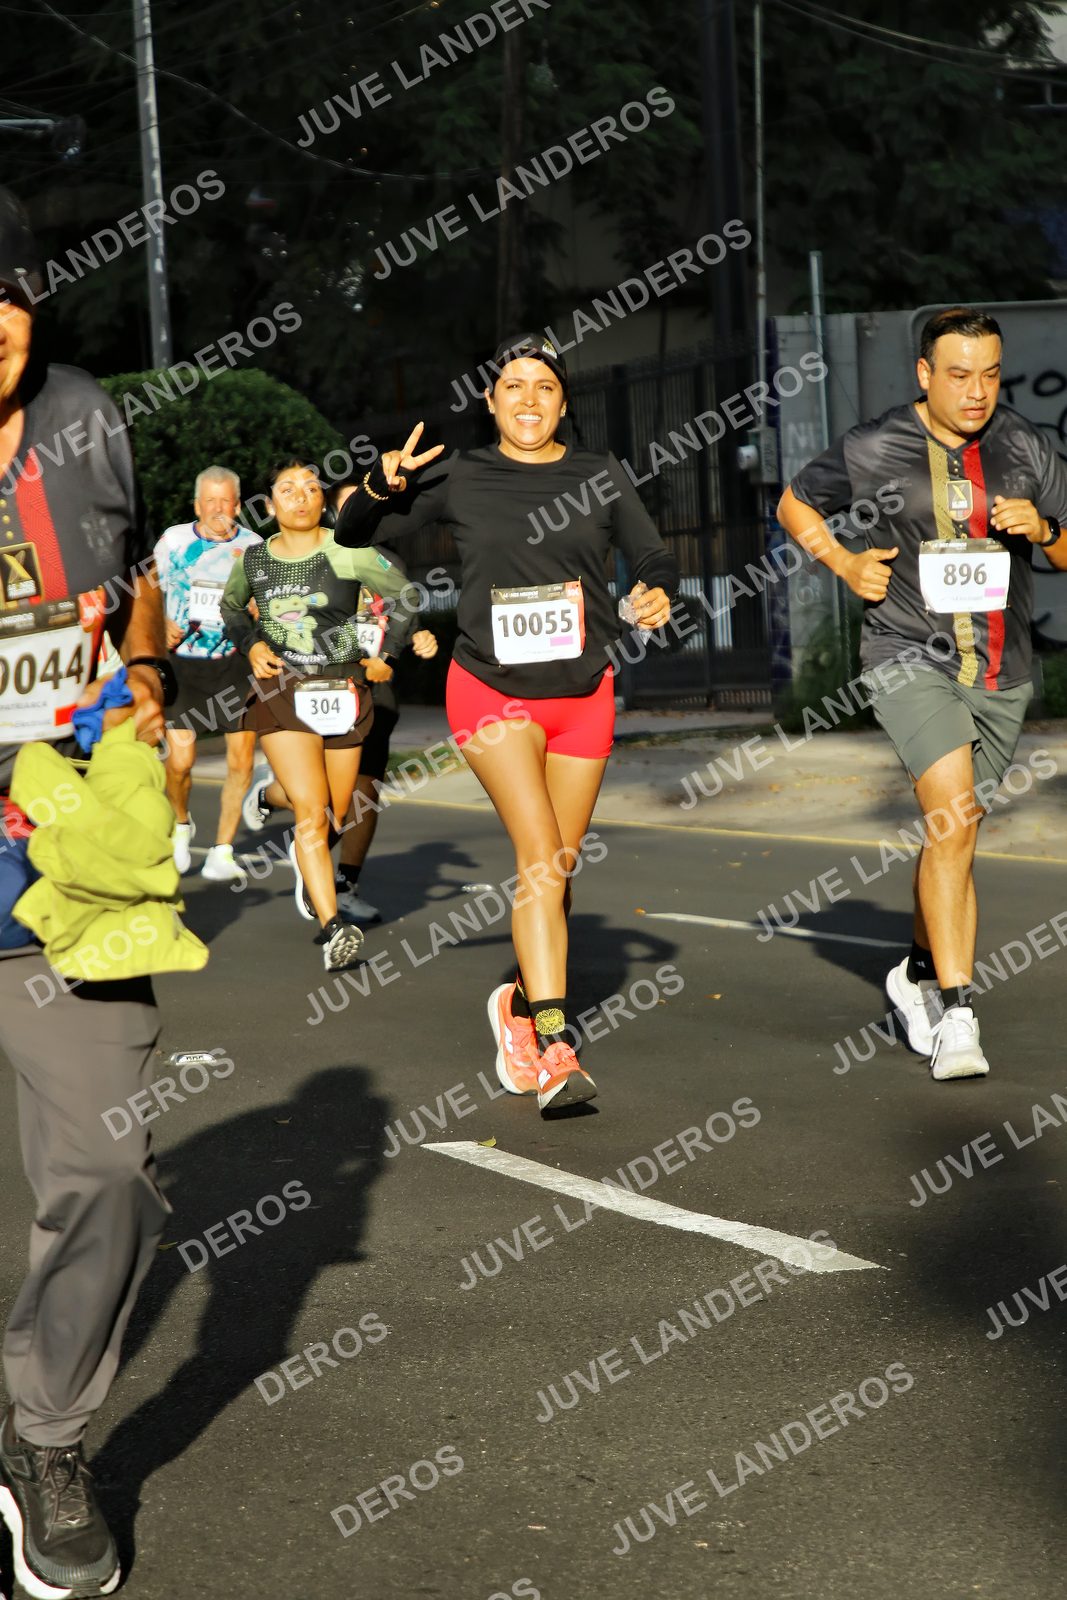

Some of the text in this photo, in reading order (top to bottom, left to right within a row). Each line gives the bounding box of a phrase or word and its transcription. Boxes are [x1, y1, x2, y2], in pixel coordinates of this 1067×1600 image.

[943, 563, 987, 586] 896
[194, 592, 222, 606] 107
[497, 609, 573, 638] 10055
[310, 697, 341, 715] 304
